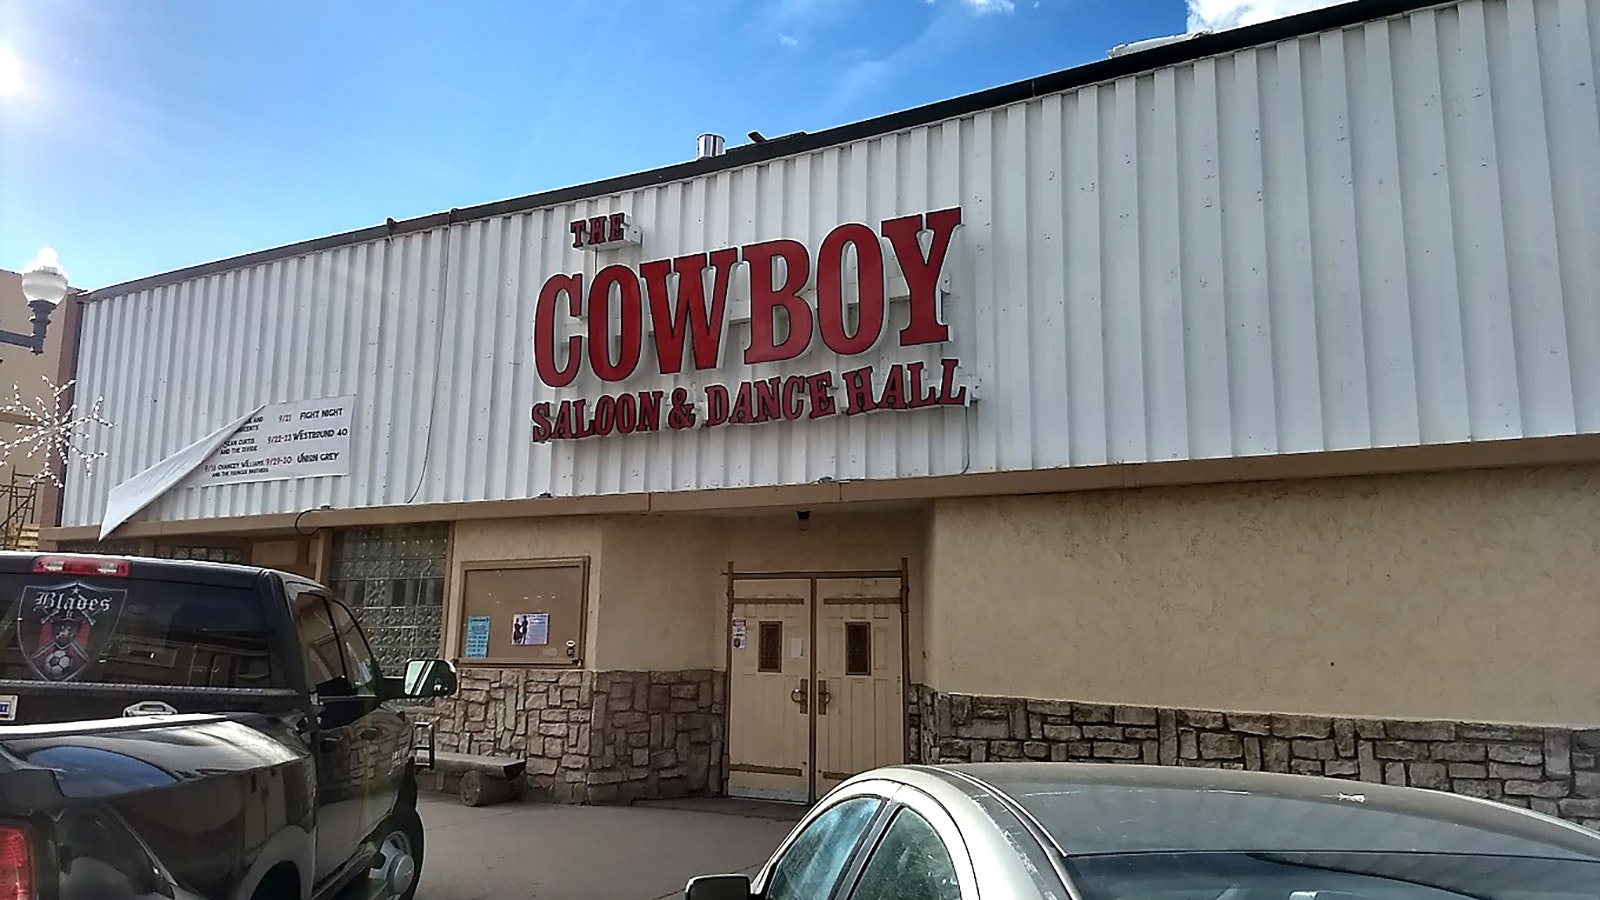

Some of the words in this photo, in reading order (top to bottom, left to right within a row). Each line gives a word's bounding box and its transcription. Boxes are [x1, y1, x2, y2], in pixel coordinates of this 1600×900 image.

[570, 213, 625, 248] THE
[534, 206, 962, 387] COWBOY
[531, 390, 663, 443] SALOON
[669, 387, 696, 429] &
[704, 370, 835, 427] DANCE
[843, 358, 967, 411] HALL
[300, 411, 319, 420] FIGHT
[321, 408, 343, 417] NIGHT
[293, 429, 334, 440] WESTBOUND
[337, 428, 348, 436] 40
[320, 453, 340, 461] GREY
[35, 592, 112, 611] Blades
